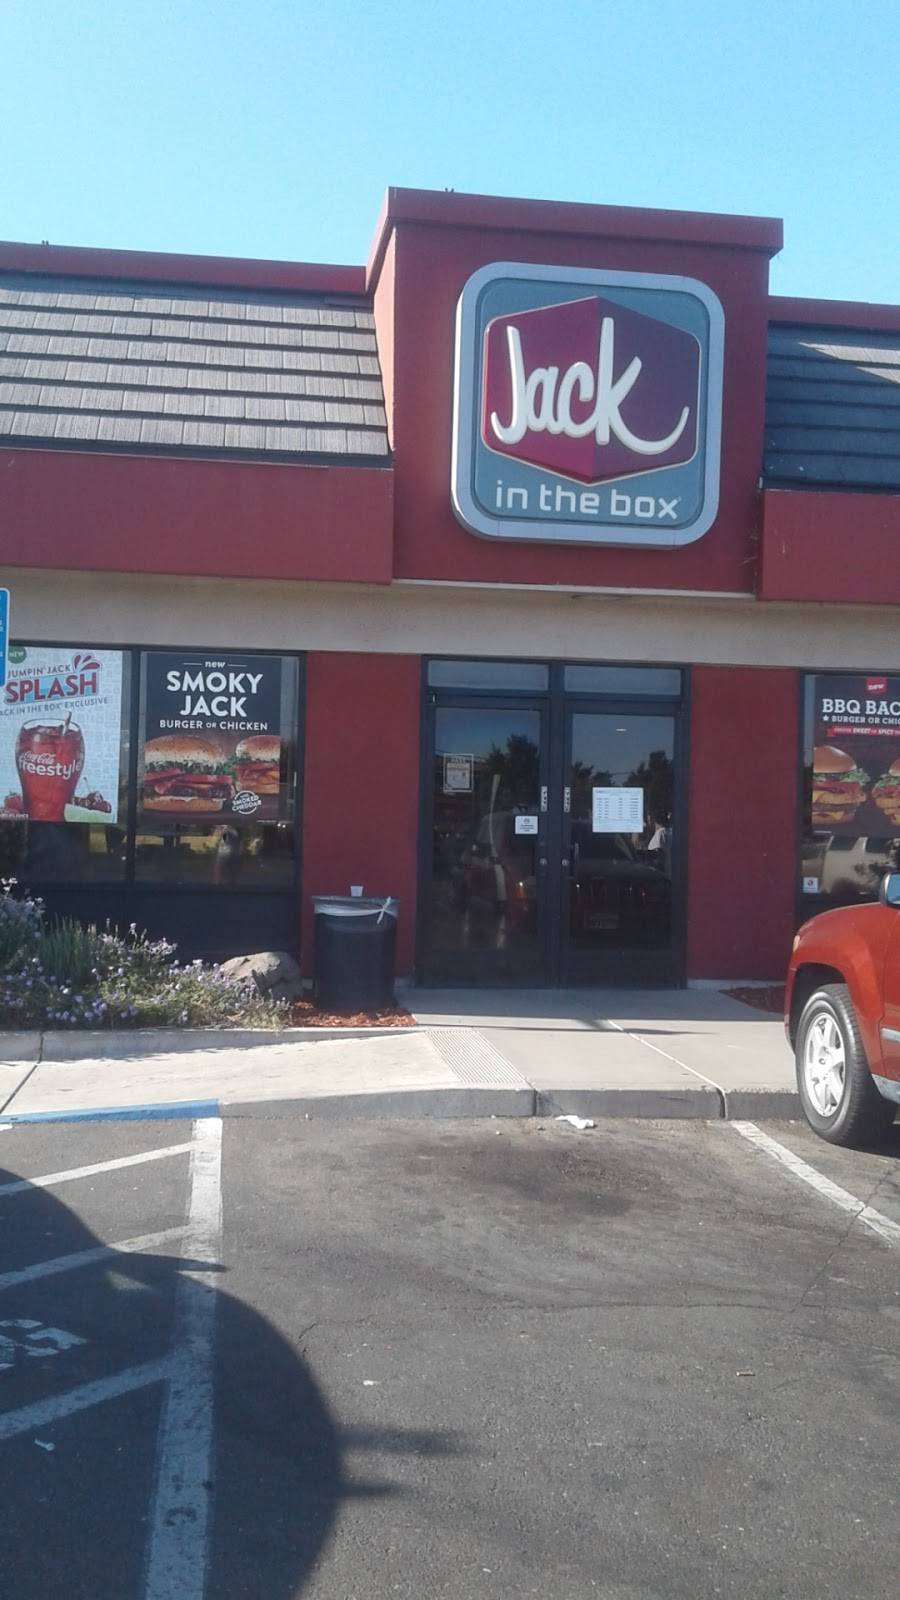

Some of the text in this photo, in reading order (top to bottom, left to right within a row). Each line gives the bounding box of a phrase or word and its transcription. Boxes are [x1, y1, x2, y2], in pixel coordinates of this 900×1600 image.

[491, 316, 690, 455] Jack
[495, 480, 679, 520] in the box
[47, 665, 70, 674] JACK
[6, 673, 97, 703] SPLASH
[166, 670, 263, 694] SMOKY
[64, 698, 107, 708] EXCLUSIVE
[179, 695, 247, 717] JACK
[822, 698, 860, 714] BBQ
[159, 719, 203, 729] BURGER
[219, 721, 268, 731] CHICKEN
[831, 715, 865, 723] BURGER
[18, 756, 82, 780] freestyle
